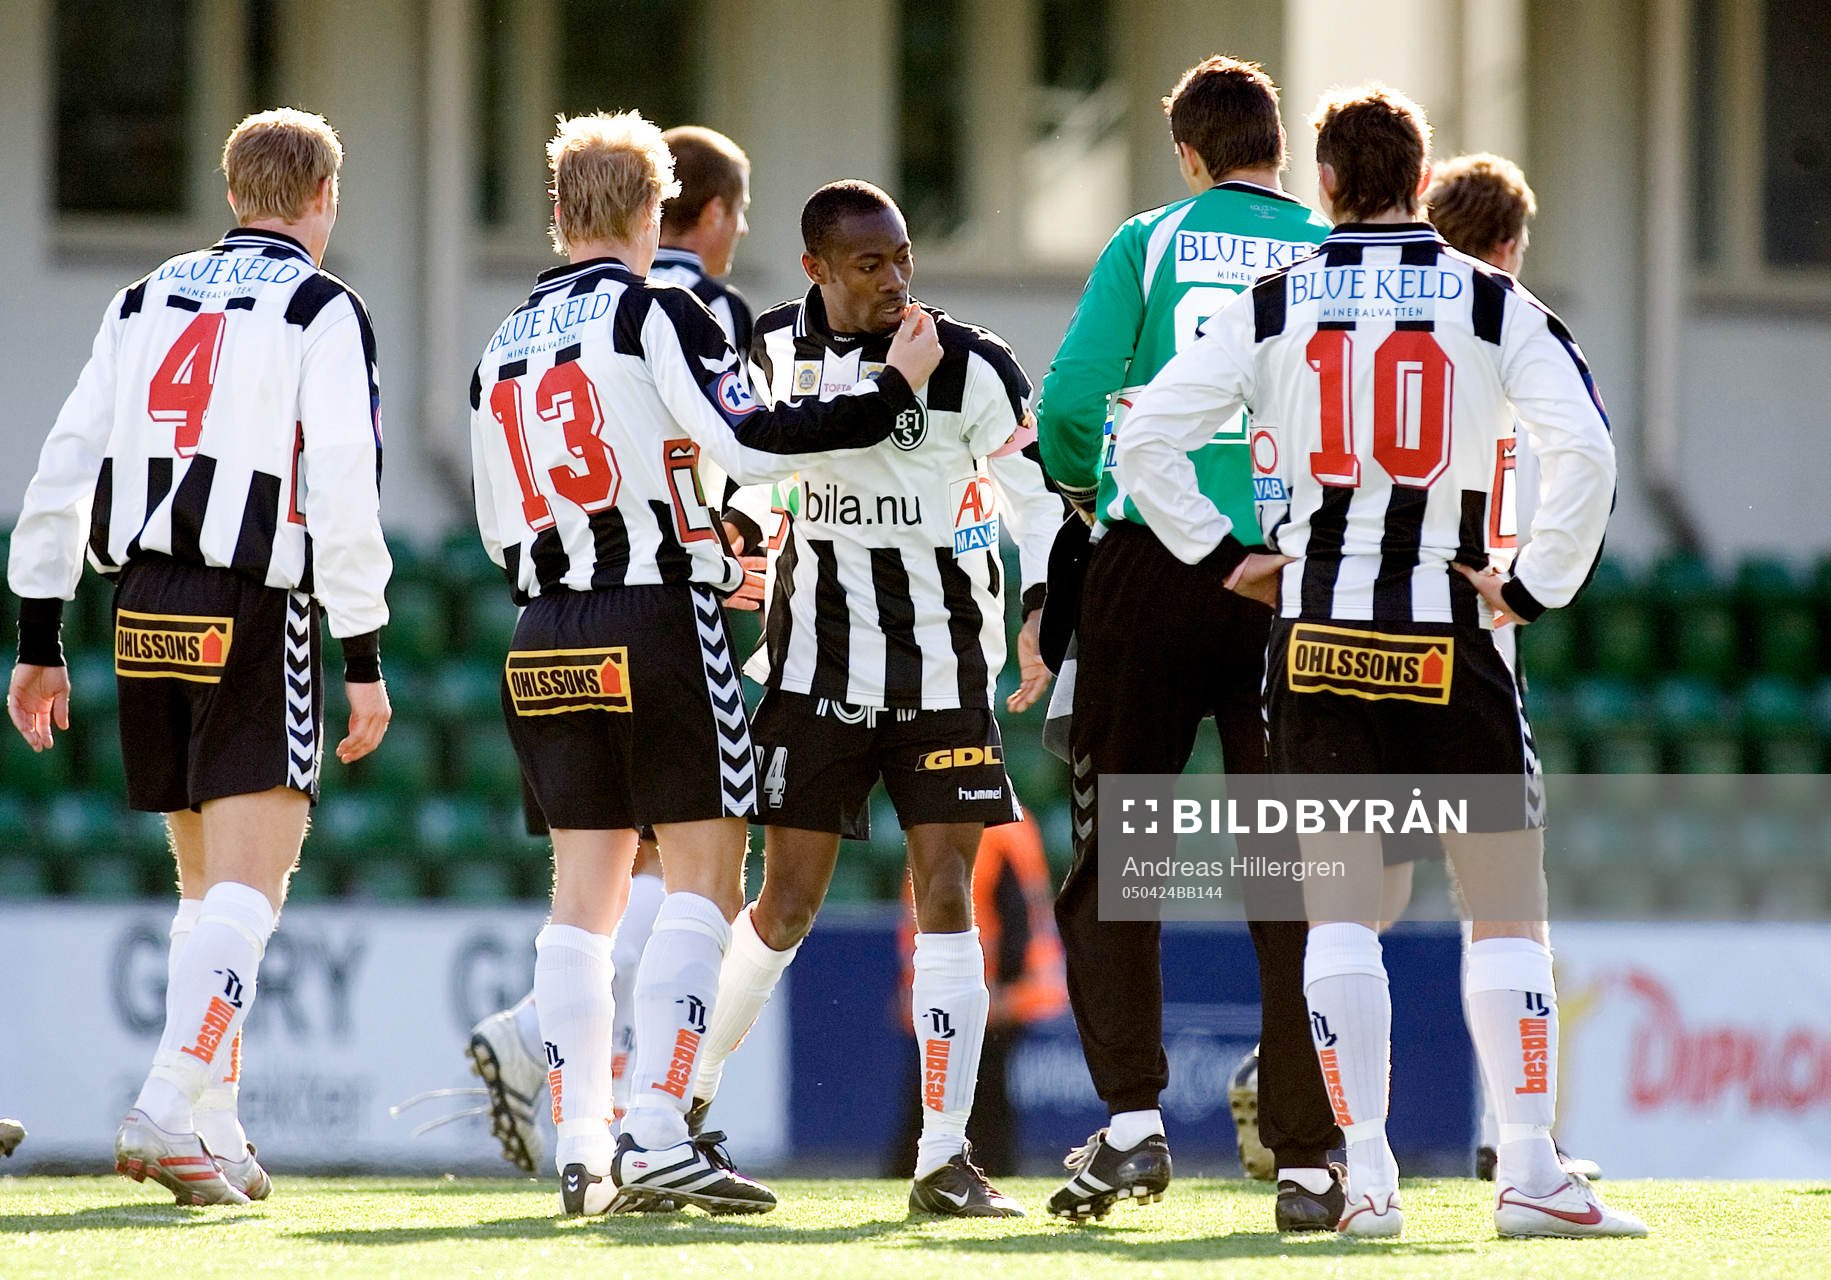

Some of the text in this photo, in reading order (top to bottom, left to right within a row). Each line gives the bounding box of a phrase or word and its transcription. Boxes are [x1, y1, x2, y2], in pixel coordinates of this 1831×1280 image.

[1178, 233, 1319, 269] BLUE KE
[158, 257, 300, 285] BLUE KELD
[1290, 269, 1464, 306] BLUE KELD
[489, 293, 611, 353] BLUE KELD
[1322, 307, 1424, 317] MINERALVATTEN
[506, 333, 577, 360] MINERALVATTEN
[149, 312, 227, 459] 4
[1306, 329, 1455, 490] 10
[490, 360, 622, 532] 13
[804, 481, 922, 526] bila.nu
[117, 629, 200, 662] OHLSSONS
[1295, 644, 1420, 683] OHLSSONS
[510, 668, 600, 698] OHLSSONS
[924, 747, 1002, 770] GDL
[958, 786, 1002, 801] hummel
[181, 996, 235, 1065] besam
[651, 1028, 702, 1100] besam
[1515, 1018, 1548, 1094] besam
